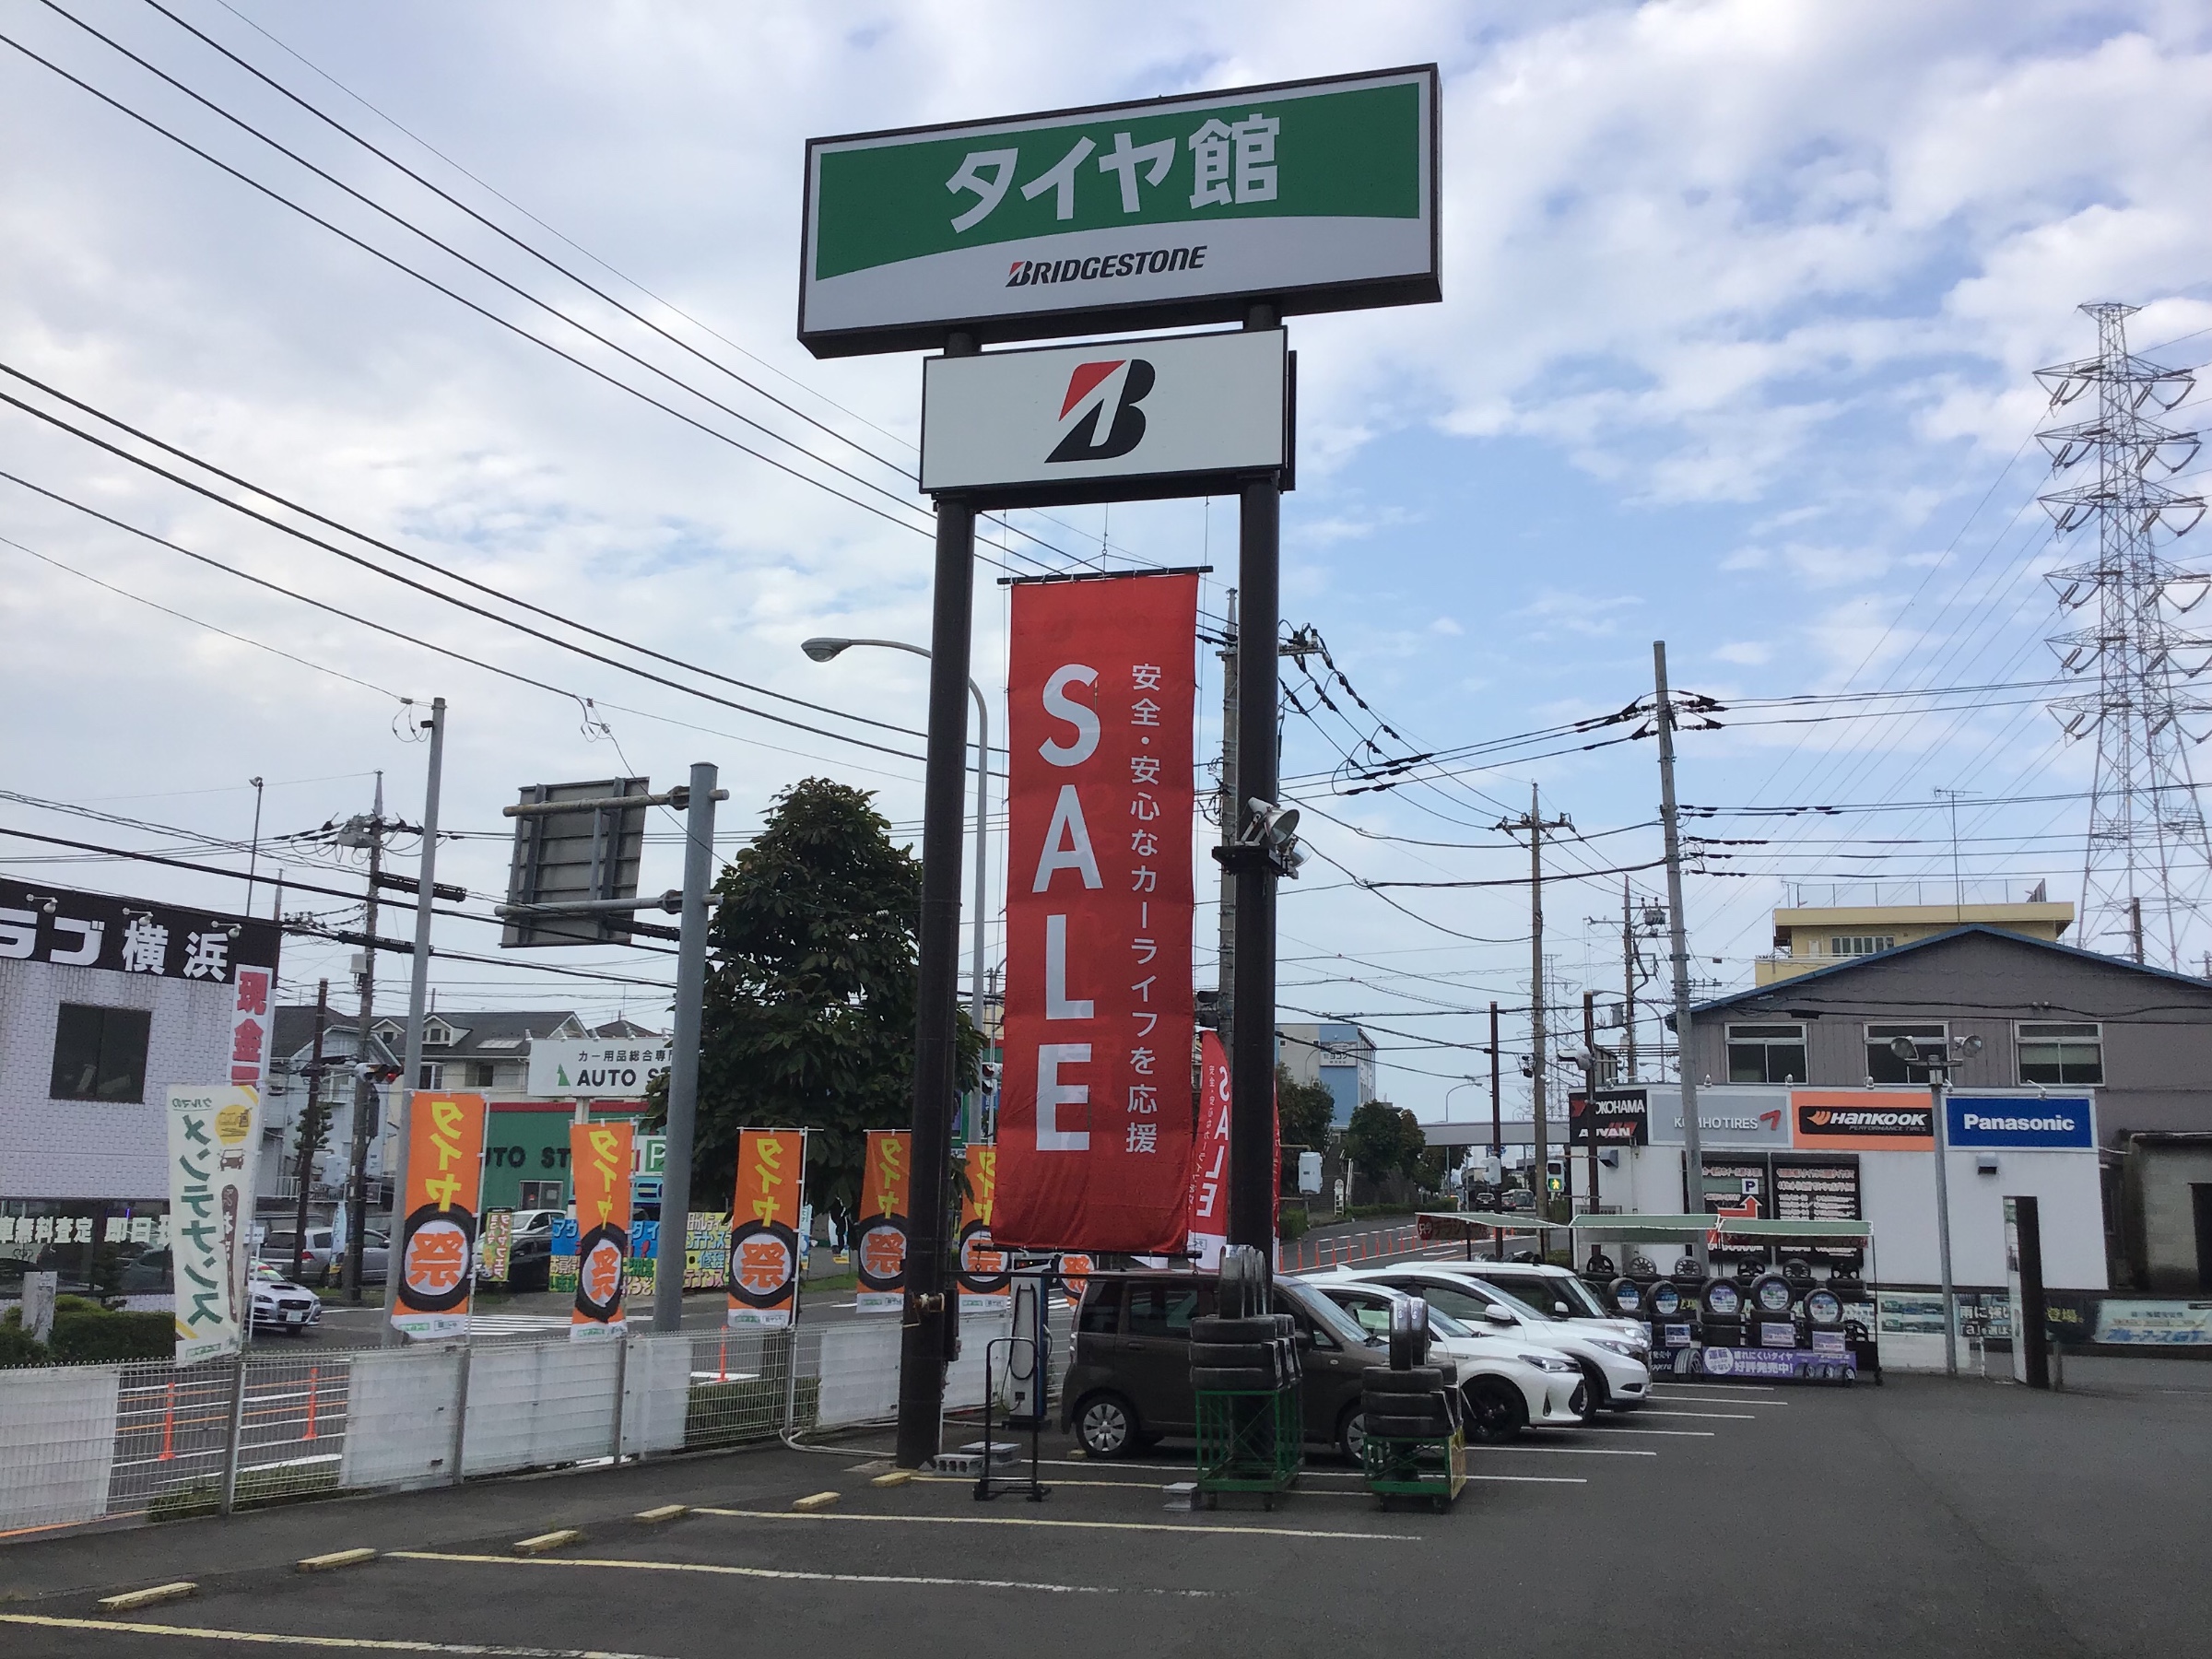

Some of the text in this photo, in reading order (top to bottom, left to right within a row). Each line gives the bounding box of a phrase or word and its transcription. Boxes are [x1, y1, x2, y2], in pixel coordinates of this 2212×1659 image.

[946, 112, 1280, 234] タイヤ館
[1005, 245, 1207, 288] BRIDGESTONE
[1032, 663, 1104, 1152] SALE
[1124, 663, 1162, 1156] 安全・安心なカーライフを応援
[0, 907, 229, 982] ラブ横浜
[577, 1068, 636, 1087] AUTO
[1594, 1099, 1645, 1115] OKOHAMA
[1578, 1127, 1630, 1137] AVAN
[1674, 1116, 1759, 1130] KHO TIRES
[1963, 1113, 2076, 1132] Panasonic
[1745, 1181, 1756, 1192] P
